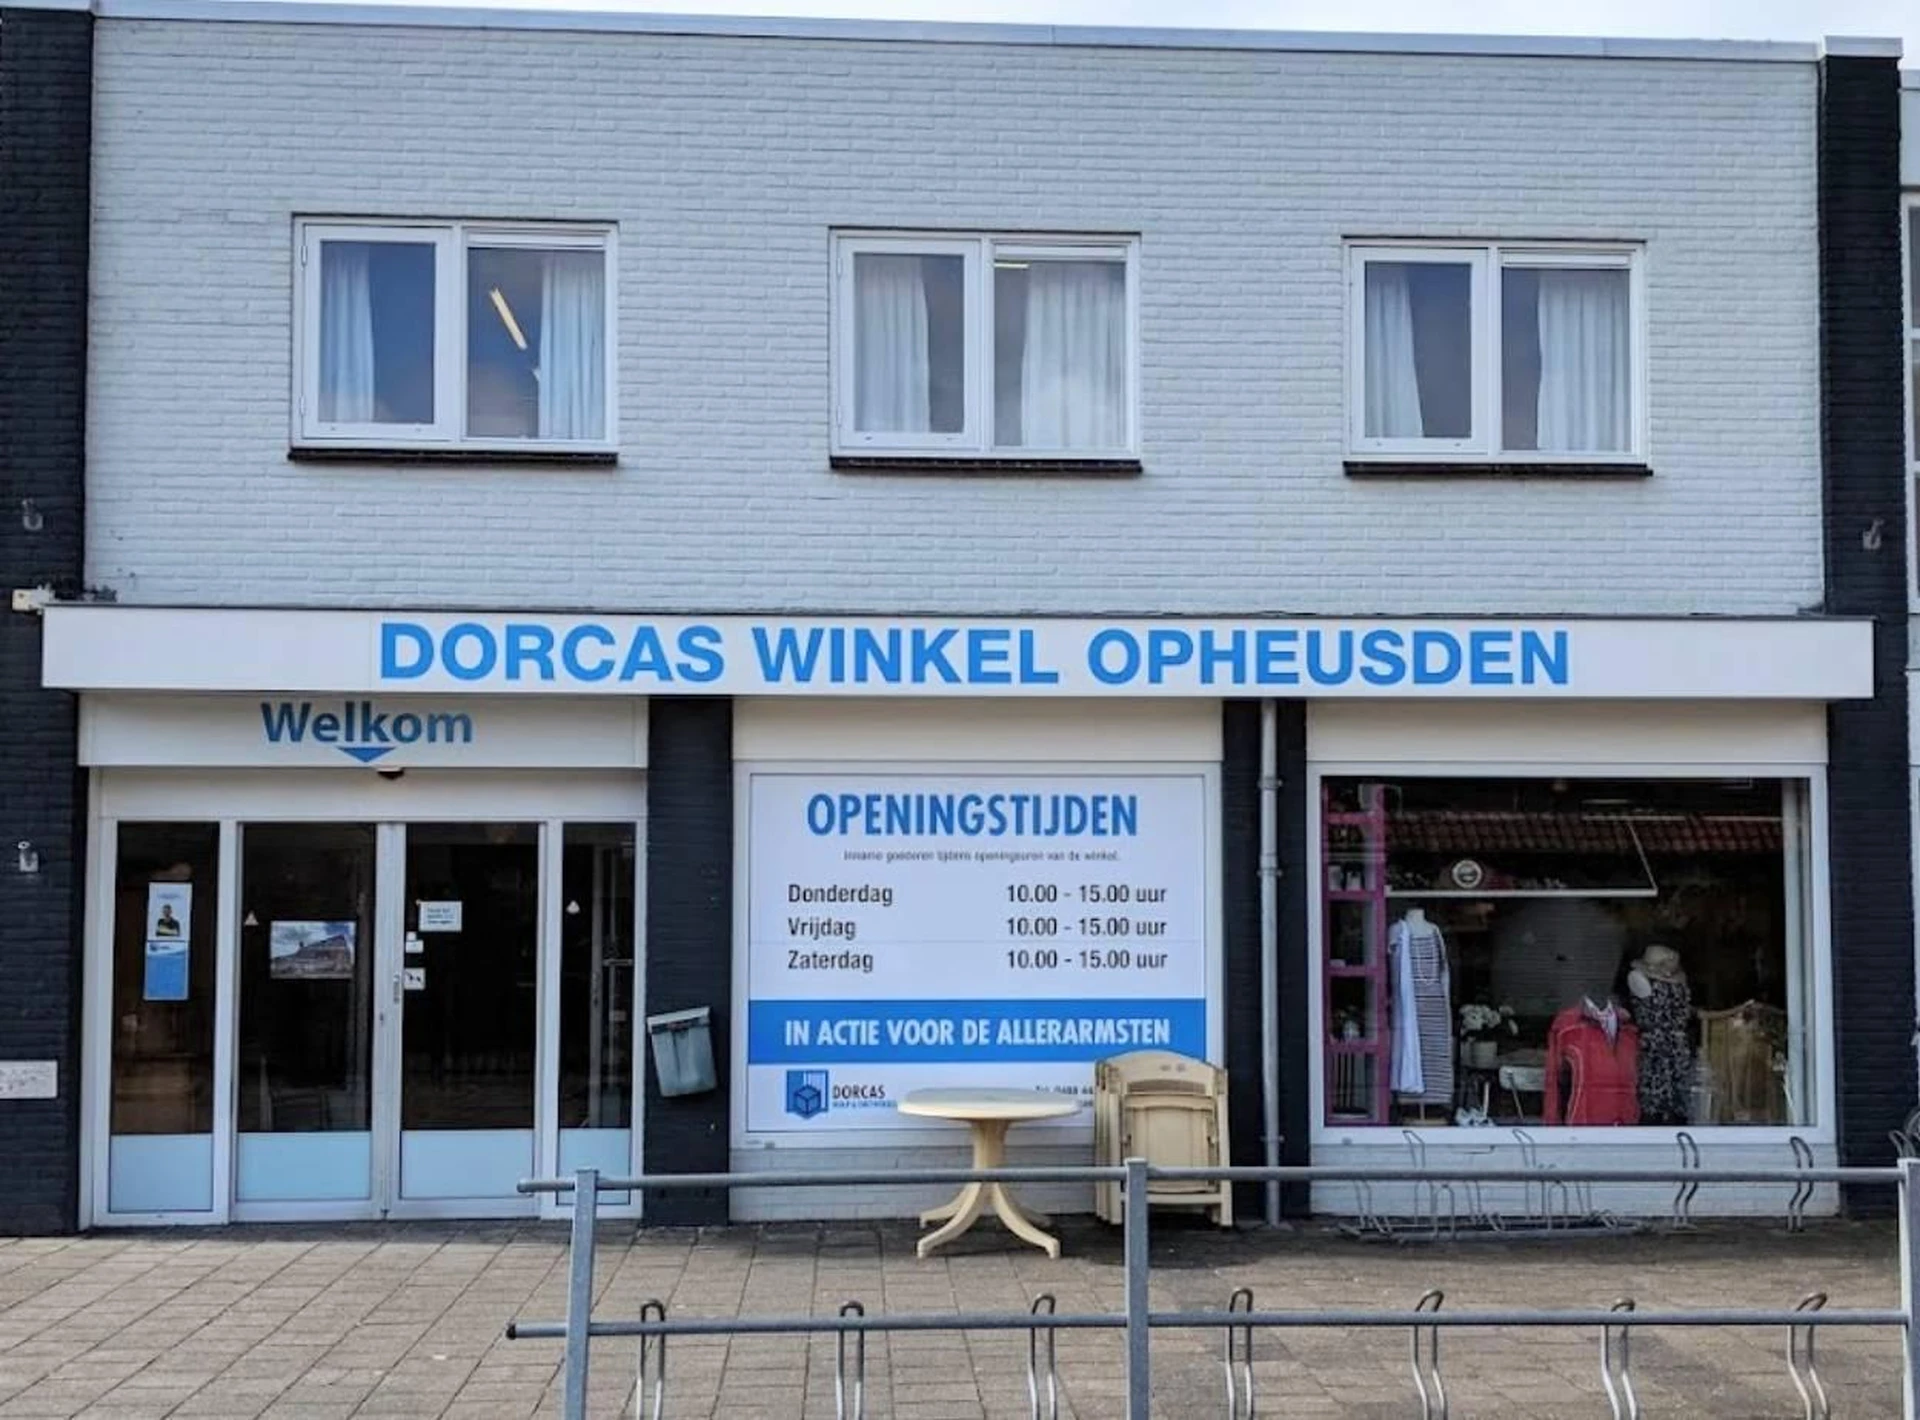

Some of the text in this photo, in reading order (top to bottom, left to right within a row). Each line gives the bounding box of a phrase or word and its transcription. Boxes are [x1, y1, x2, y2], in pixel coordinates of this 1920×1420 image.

[379, 622, 1569, 686] DORCAS WINKEL OPHEUSDEN
[260, 700, 472, 744] Welkom
[807, 793, 1138, 837] OPENINGSTIJDEN
[788, 884, 893, 907] Donderdag
[1008, 884, 1058, 903] 10.00
[1079, 884, 1130, 903] 15.00
[1136, 888, 1168, 903] uur
[788, 917, 856, 941] Vrijdag
[1008, 917, 1058, 936] 10.00
[1079, 917, 1130, 936] 15.00
[1136, 921, 1168, 936] uur
[788, 949, 874, 973] Zaterdag
[1008, 950, 1058, 969] 10.00
[1079, 950, 1130, 969] 15.00
[1136, 954, 1168, 969] uur
[785, 1018, 1171, 1046] IN ACTIE VOOR DE ALLERARMSTEN
[832, 1084, 886, 1100] DORCAS
